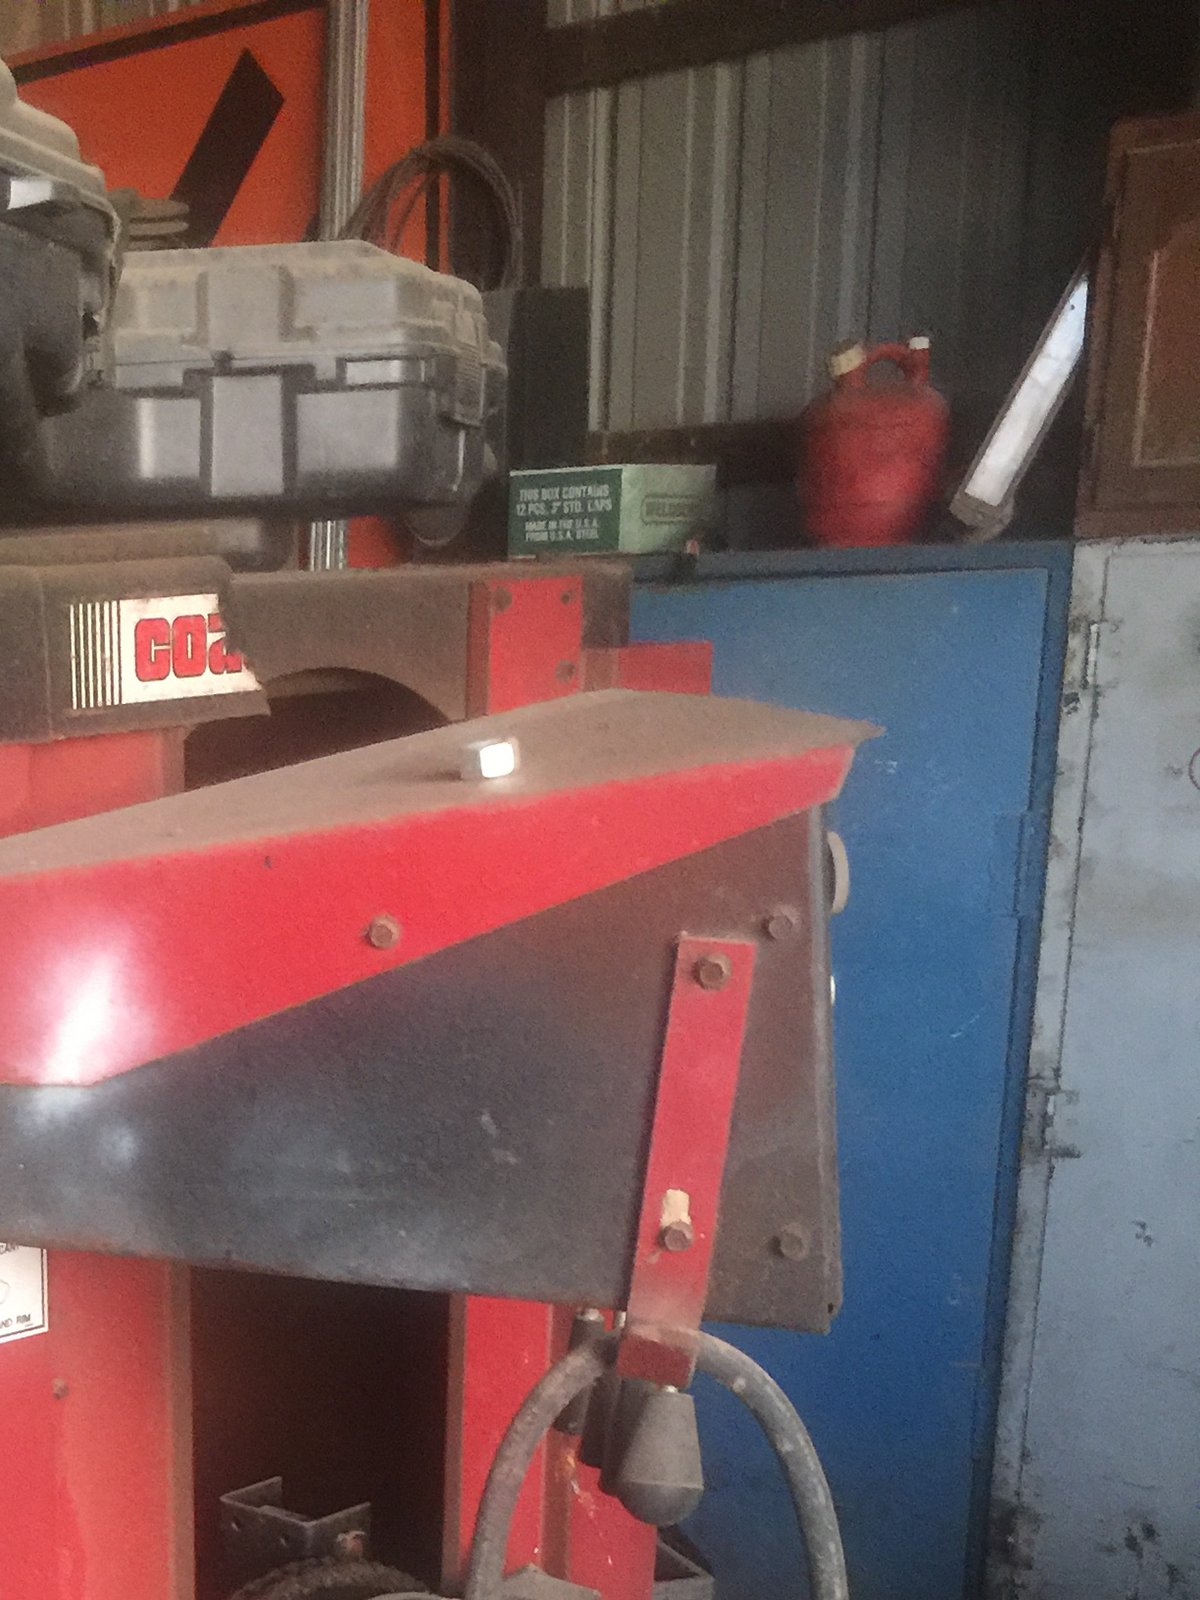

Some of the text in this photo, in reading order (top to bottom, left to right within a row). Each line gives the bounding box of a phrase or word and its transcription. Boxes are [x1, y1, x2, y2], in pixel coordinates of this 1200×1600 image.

[520, 484, 610, 501] THIS BOX CONTAINS
[516, 504, 528, 516] 12
[525, 520, 548, 531] MADE
[16, 1313, 31, 1324] RIM
